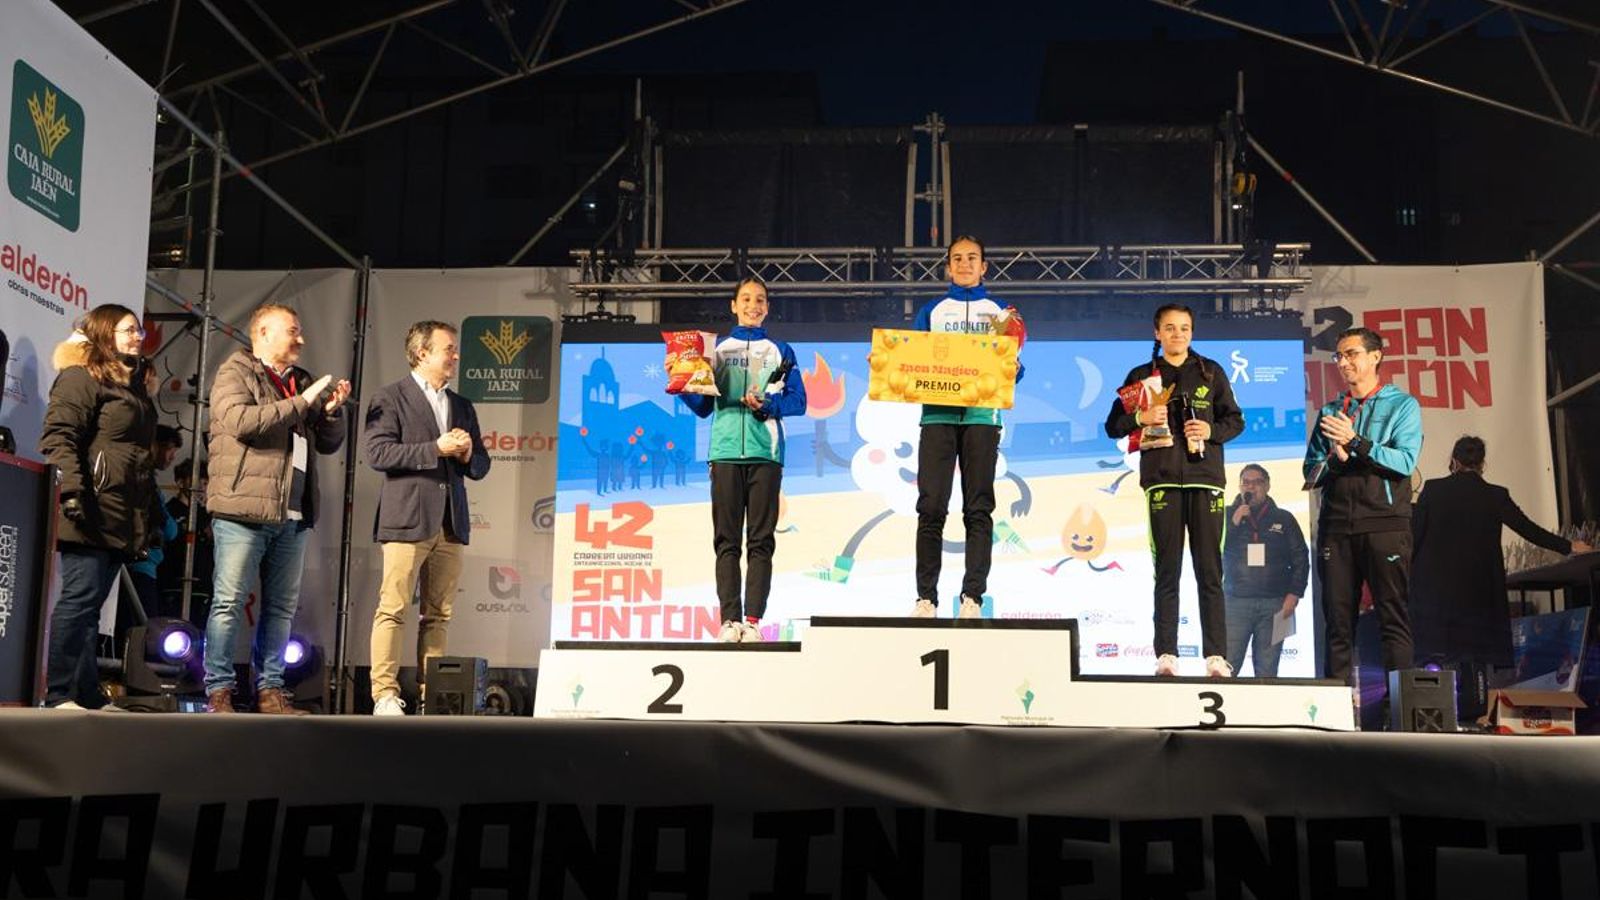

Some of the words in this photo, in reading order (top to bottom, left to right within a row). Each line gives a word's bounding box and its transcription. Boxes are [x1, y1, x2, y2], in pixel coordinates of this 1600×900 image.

[14, 143, 39, 172] CAJA
[41, 161, 75, 195] RURAL
[0, 244, 88, 310] alderón
[8, 279, 28, 296] obras
[30, 292, 64, 315] maestras
[1363, 307, 1488, 356] SAN
[466, 369, 497, 379] CAJA
[500, 368, 544, 379] RURAL
[915, 380, 961, 392] PREMIO
[575, 501, 654, 550] 42
[574, 552, 615, 560] CARRERA
[617, 552, 653, 560] URBANA
[572, 569, 663, 602] SAN
[647, 664, 685, 714] 2
[920, 649, 949, 711] 1
[1198, 691, 1226, 729] 3
[0, 793, 159, 900] RA
[186, 797, 713, 900] URBANA
